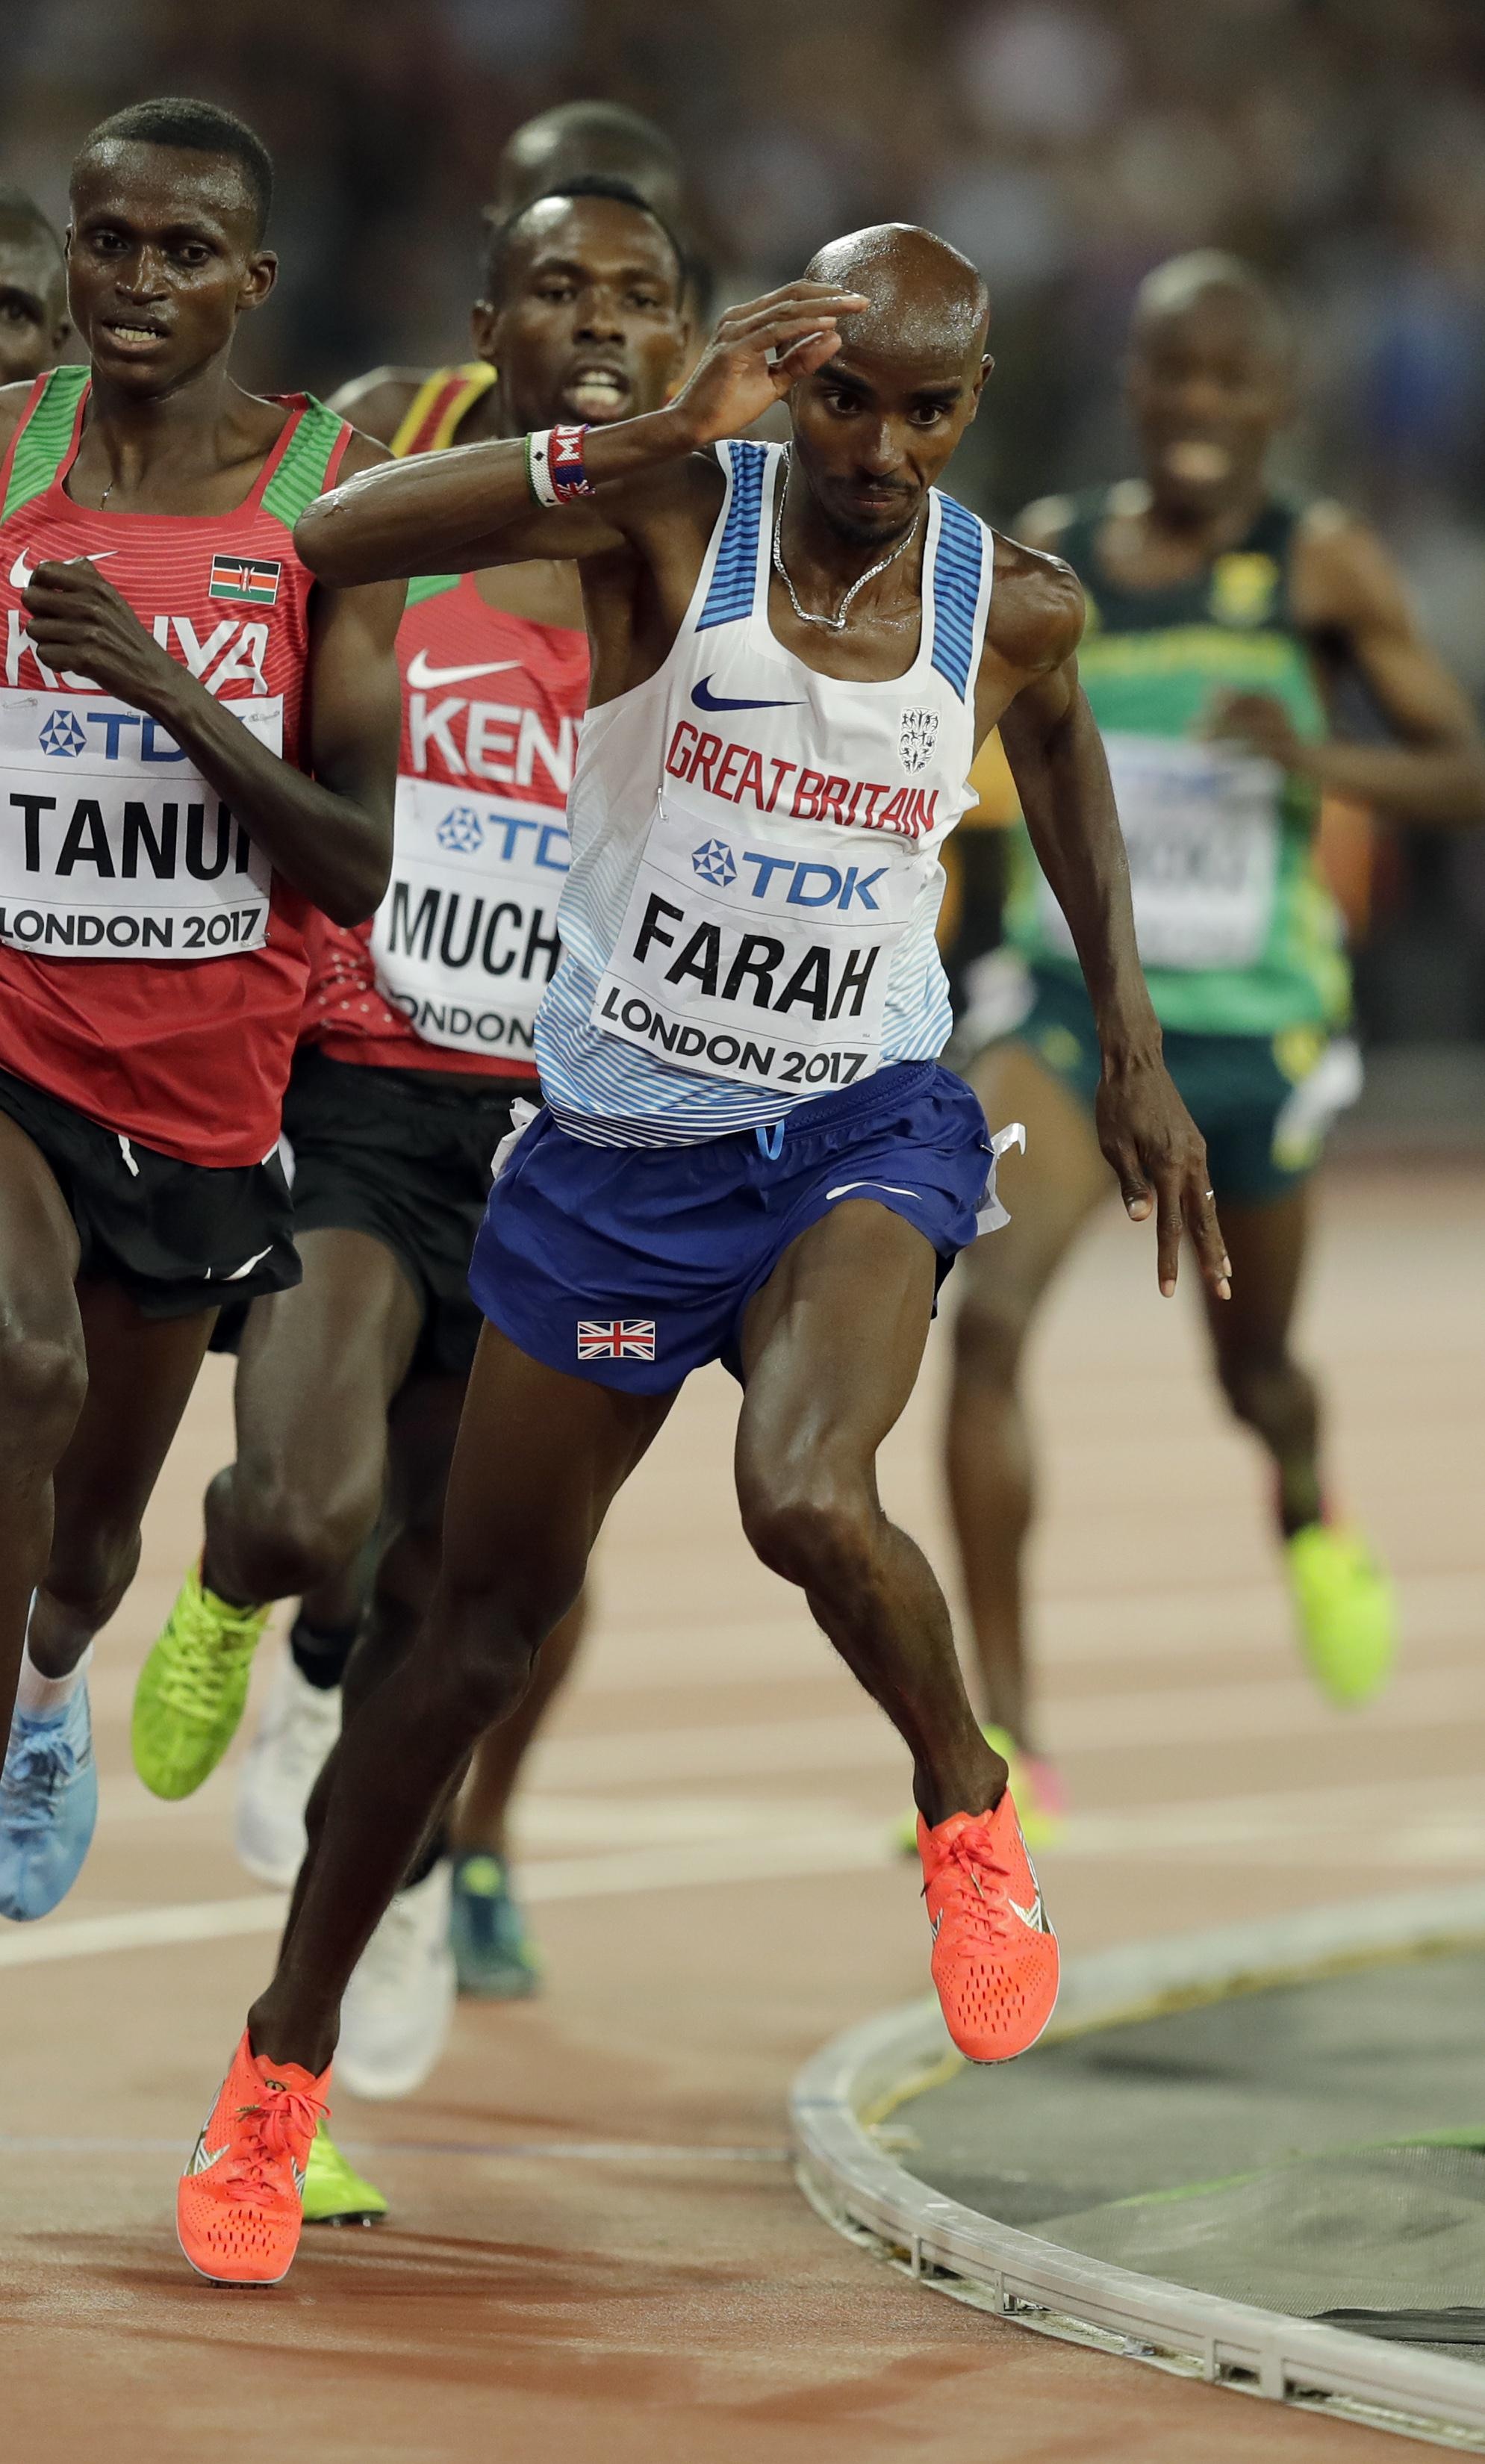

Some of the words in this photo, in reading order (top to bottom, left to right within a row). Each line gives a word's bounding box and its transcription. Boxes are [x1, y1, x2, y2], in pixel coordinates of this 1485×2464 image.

[5, 609, 269, 694] KYA
[87, 711, 245, 762] TD
[408, 694, 585, 794] KEN
[665, 721, 799, 812] GREAT
[789, 768, 939, 840] BRITAIN
[10, 793, 250, 880] TANUI
[741, 851, 891, 911] TDK
[0, 907, 173, 948] LONDON
[182, 908, 262, 948] 2017
[632, 892, 882, 1021] FARAH
[389, 988, 535, 1048] ONDON
[600, 986, 775, 1075] LONDON
[776, 1051, 868, 1084] 2017
